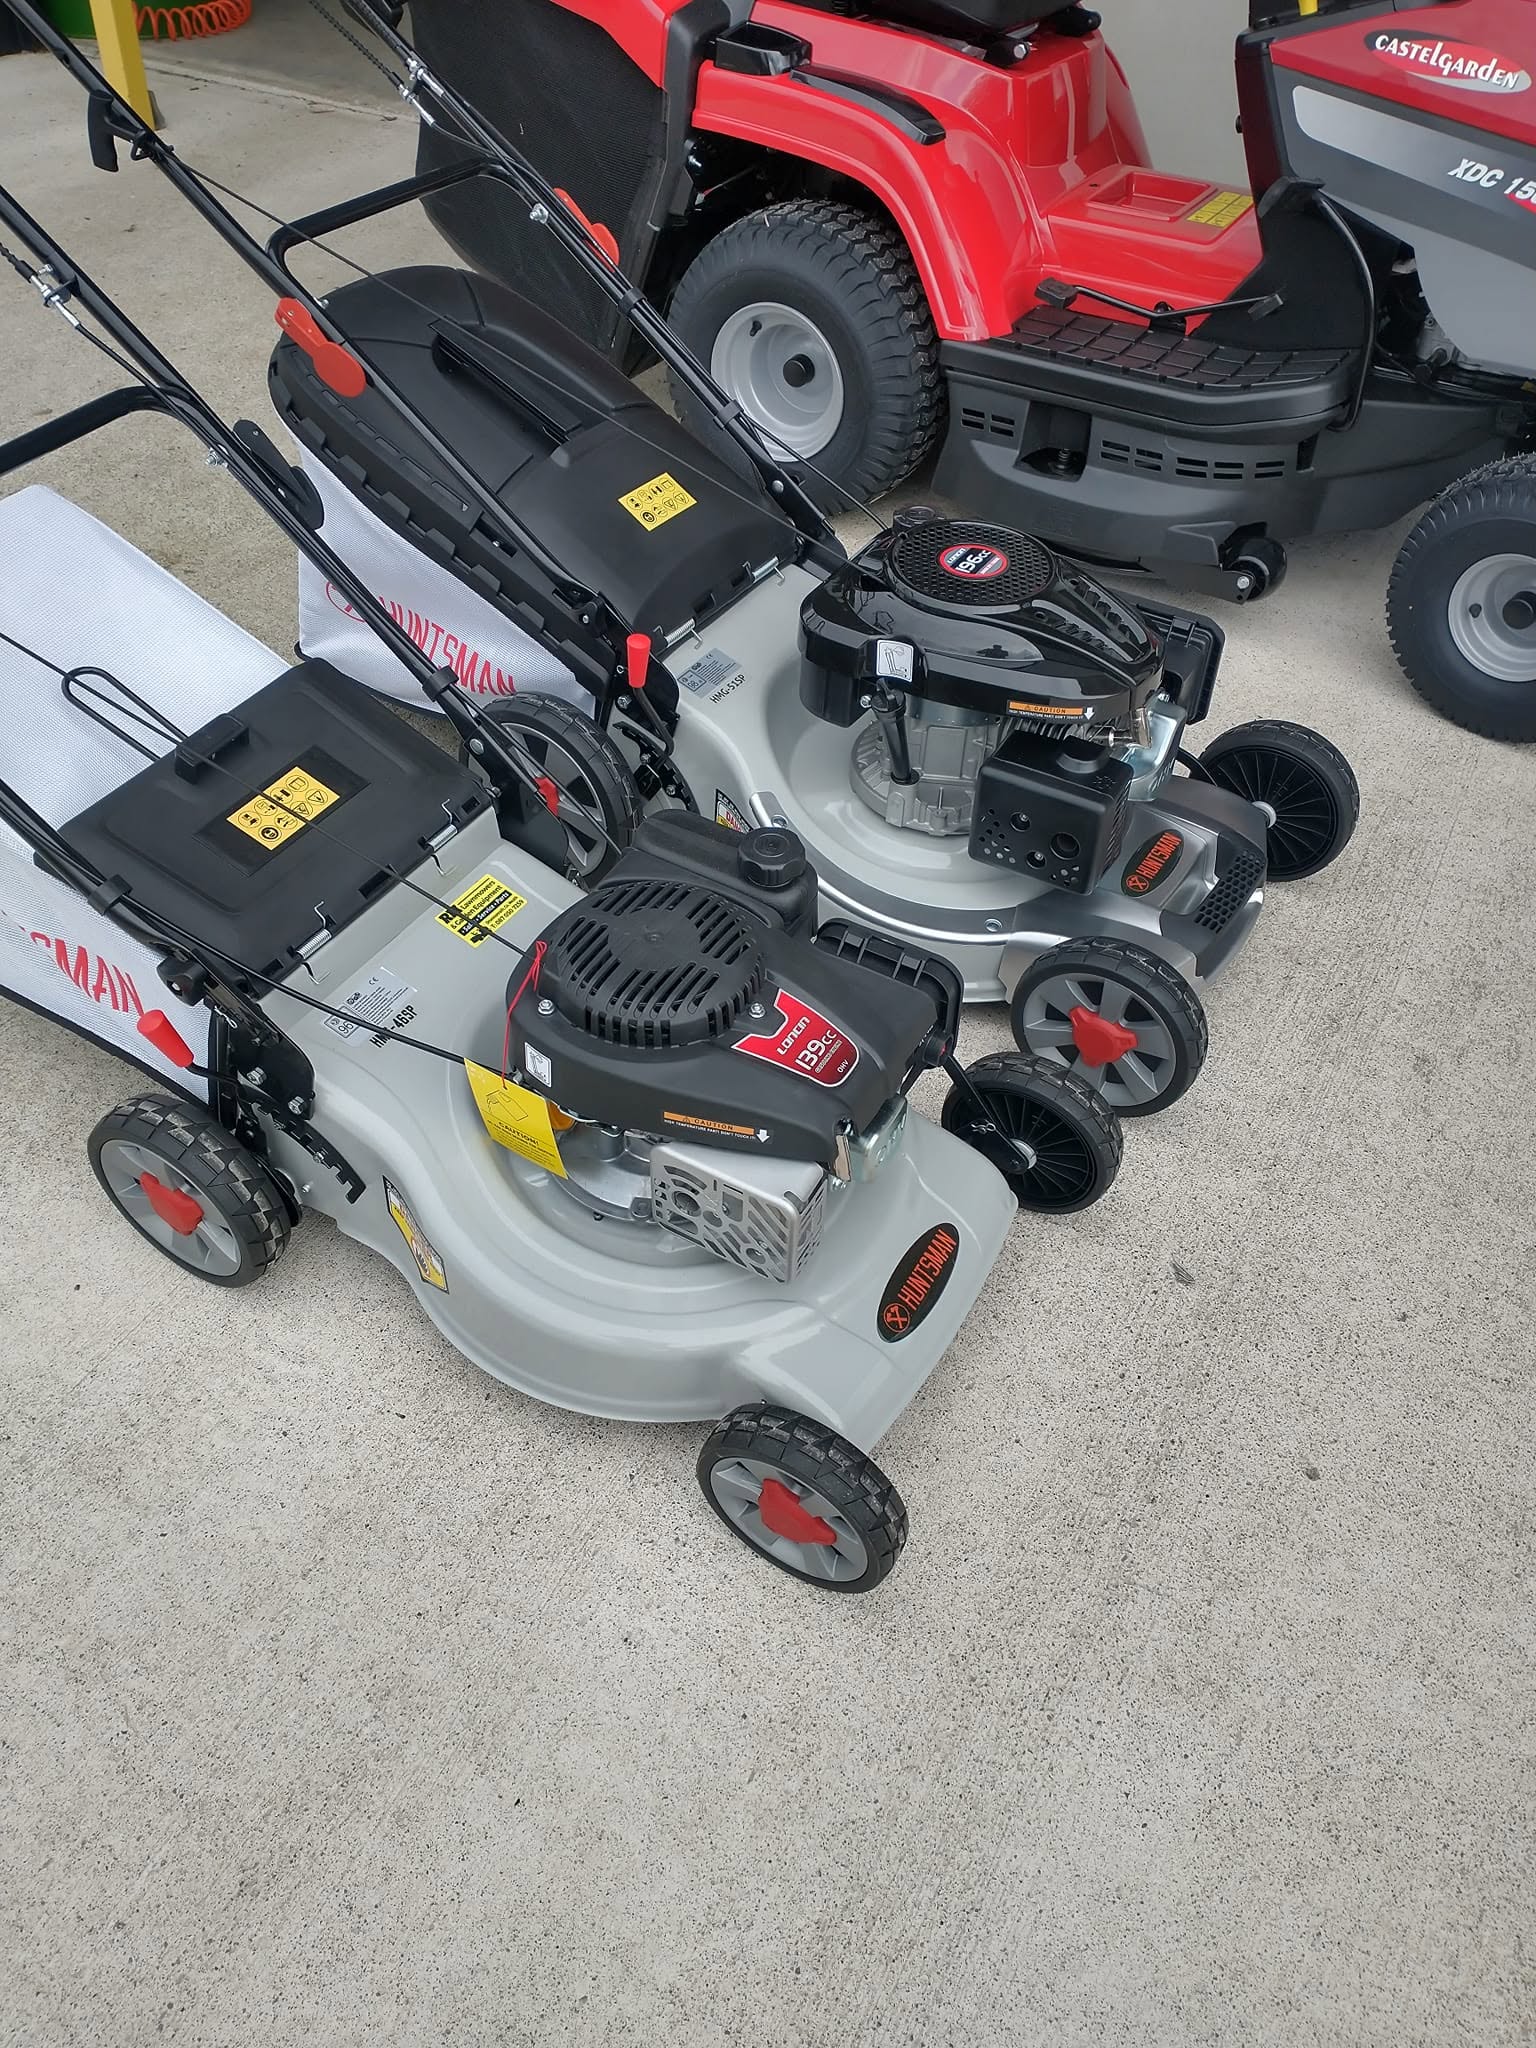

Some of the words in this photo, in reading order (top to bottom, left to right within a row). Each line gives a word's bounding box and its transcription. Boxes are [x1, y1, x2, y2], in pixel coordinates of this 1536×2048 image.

[1448, 158, 1504, 188] XDC
[1504, 177, 1536, 204] 15
[955, 550, 992, 573] 196cc
[1034, 706, 1066, 714] CAUTION
[1136, 832, 1181, 879] HUNTSMAN
[460, 880, 496, 909] Lawnmowers
[473, 885, 503, 910] Equipment
[477, 904, 495, 919] Service
[496, 892, 509, 904] Parts
[795, 1030, 837, 1071] 139cc
[837, 1060, 849, 1073] OHV
[695, 1118, 733, 1131] CAUTION
